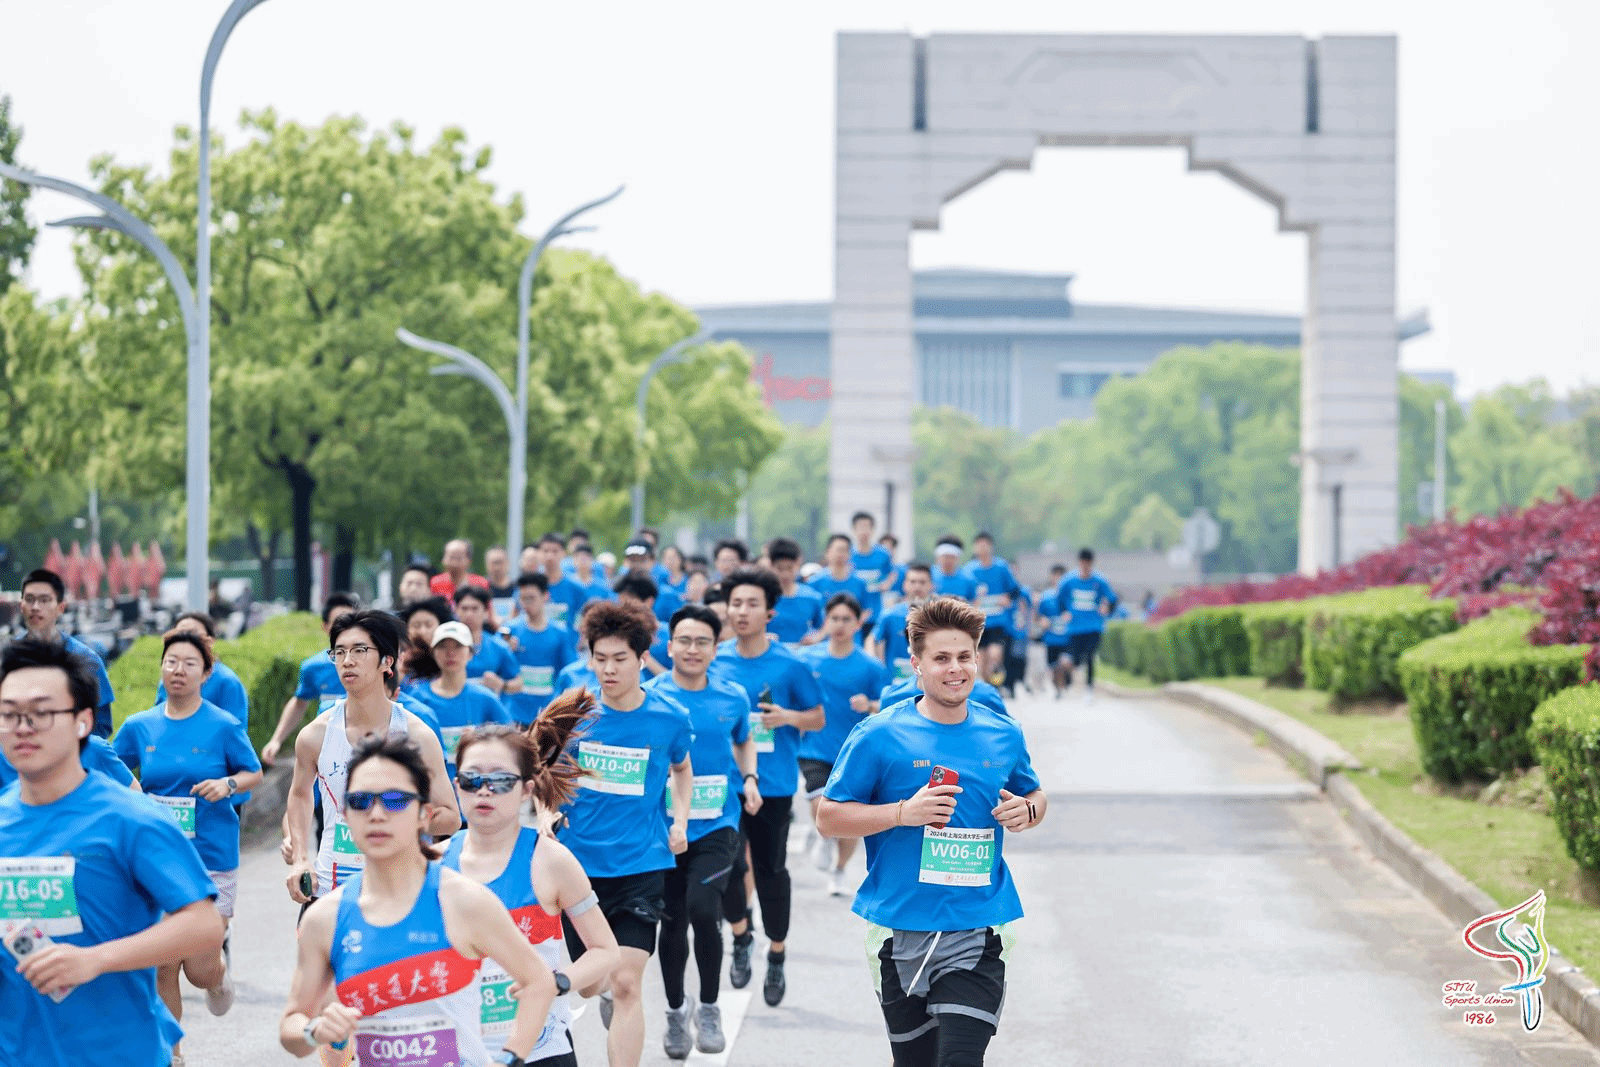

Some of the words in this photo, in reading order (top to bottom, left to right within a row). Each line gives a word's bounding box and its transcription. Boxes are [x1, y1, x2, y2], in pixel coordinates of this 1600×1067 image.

[584, 755, 640, 773] W10-04
[912, 760, 931, 768] SEMIR
[694, 788, 723, 799] 1-04
[931, 842, 990, 860] W06-01
[0, 879, 64, 901] 16-05
[370, 1035, 438, 1059] C0042
